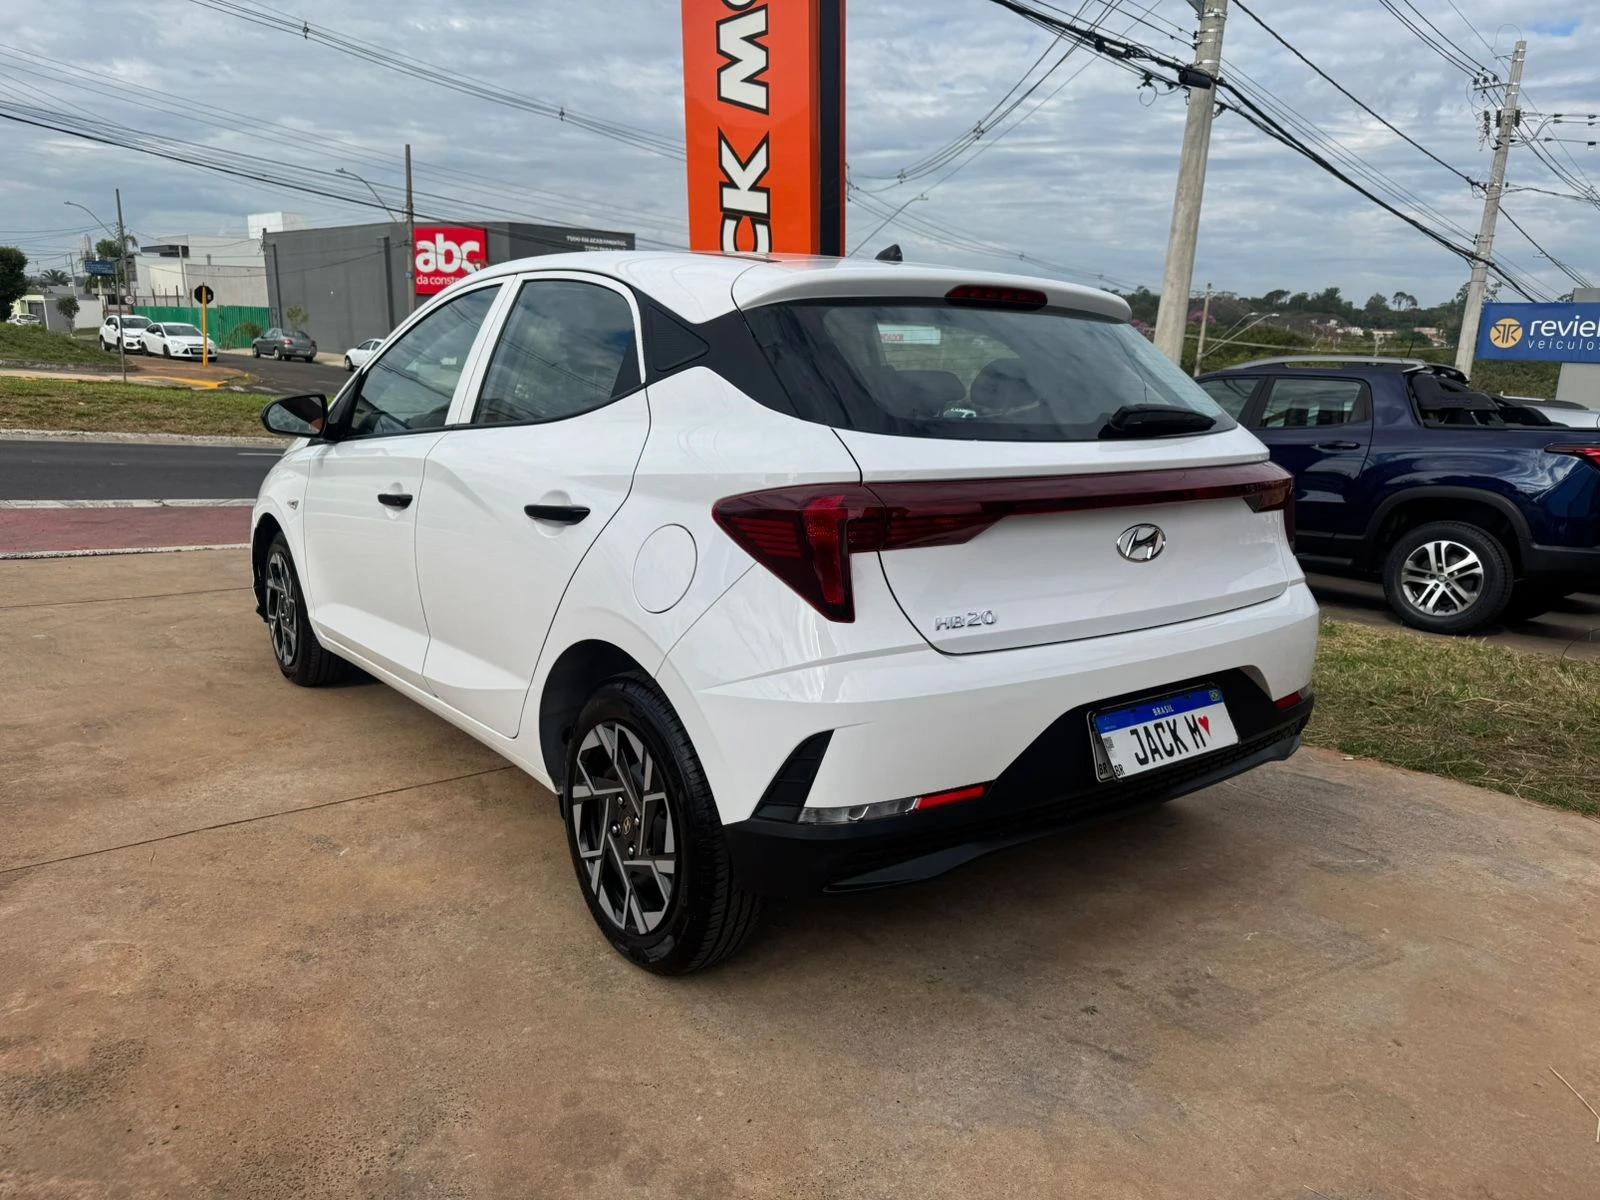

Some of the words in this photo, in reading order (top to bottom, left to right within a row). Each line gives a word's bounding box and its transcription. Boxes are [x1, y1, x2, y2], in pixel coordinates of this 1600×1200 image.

[716, 0, 769, 116] M
[415, 233, 480, 273] abc
[416, 275, 429, 285] da
[934, 609, 997, 632] HB20
[1152, 704, 1174, 716] BRASIL
[1130, 718, 1188, 765] JACK
